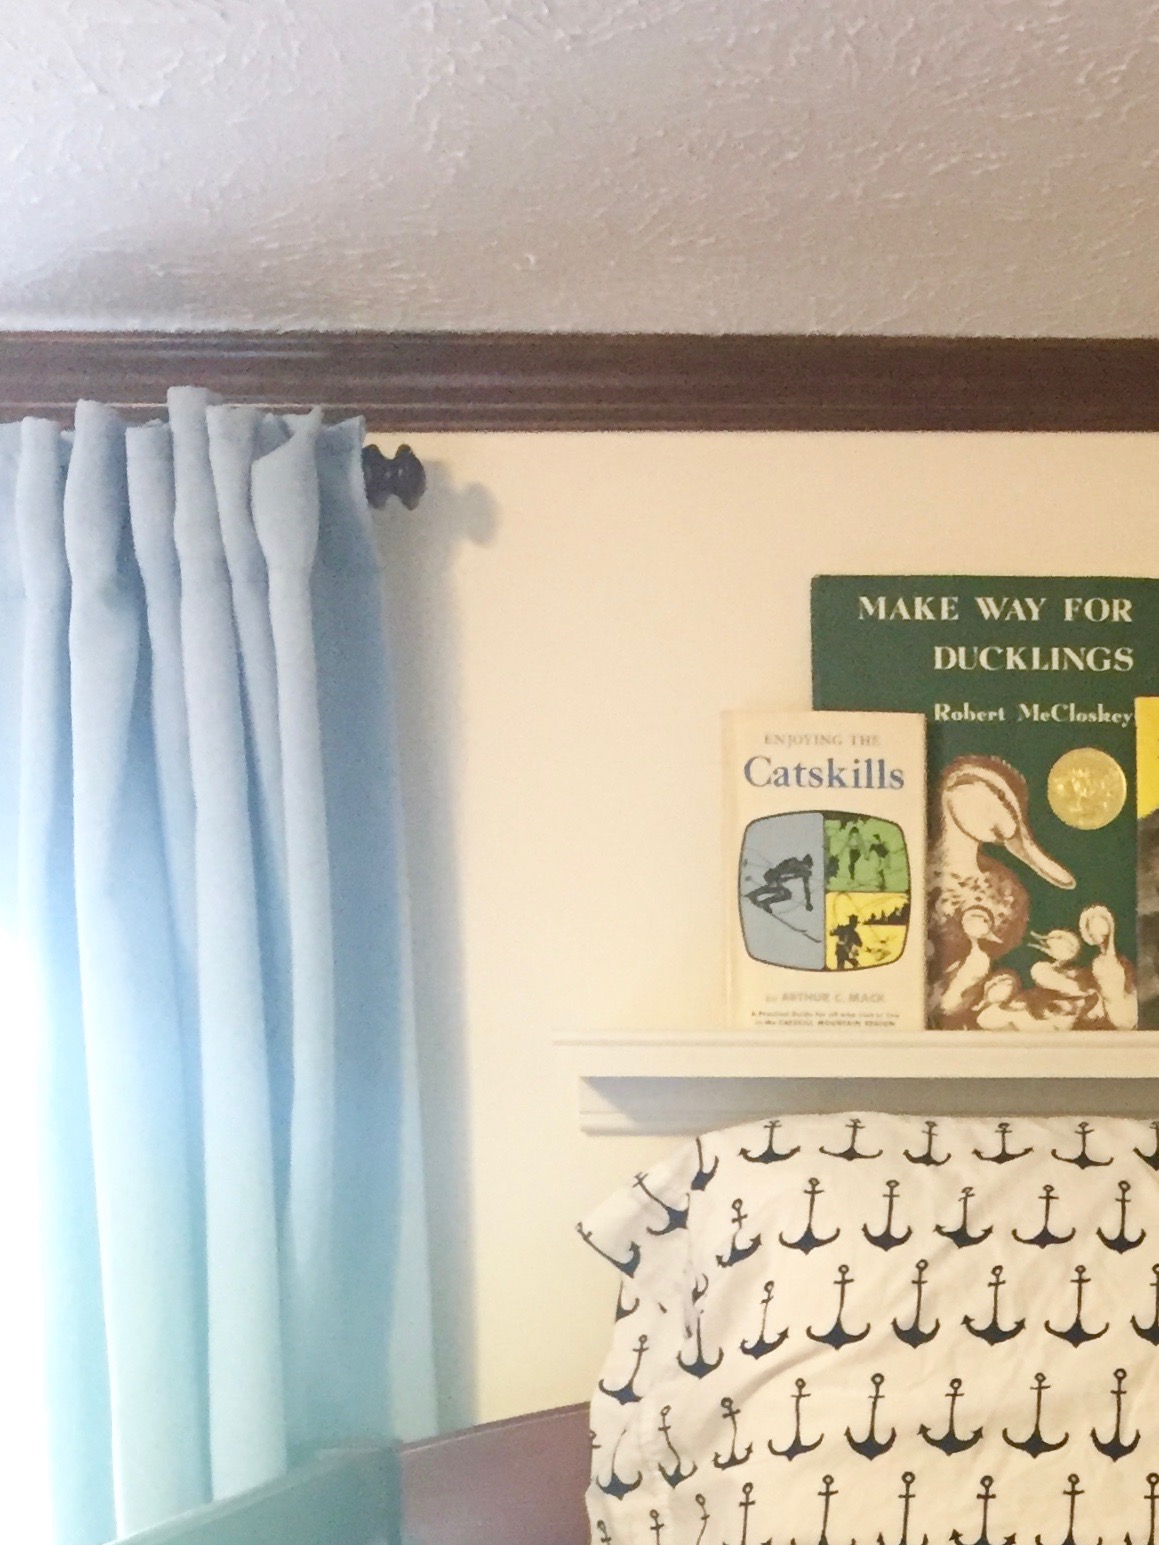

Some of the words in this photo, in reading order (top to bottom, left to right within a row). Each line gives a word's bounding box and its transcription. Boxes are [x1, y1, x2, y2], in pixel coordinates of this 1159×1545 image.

[858, 596, 959, 621] MAKE
[974, 597, 1046, 622] WAY
[1063, 598, 1132, 623] FOR
[933, 646, 1134, 672] DUCKLINGS
[934, 702, 1005, 722] Robert
[1018, 703, 1135, 728] McCloskey
[764, 733, 843, 749] ENJOYING
[850, 733, 880, 746] THE
[744, 755, 905, 790] Catskills
